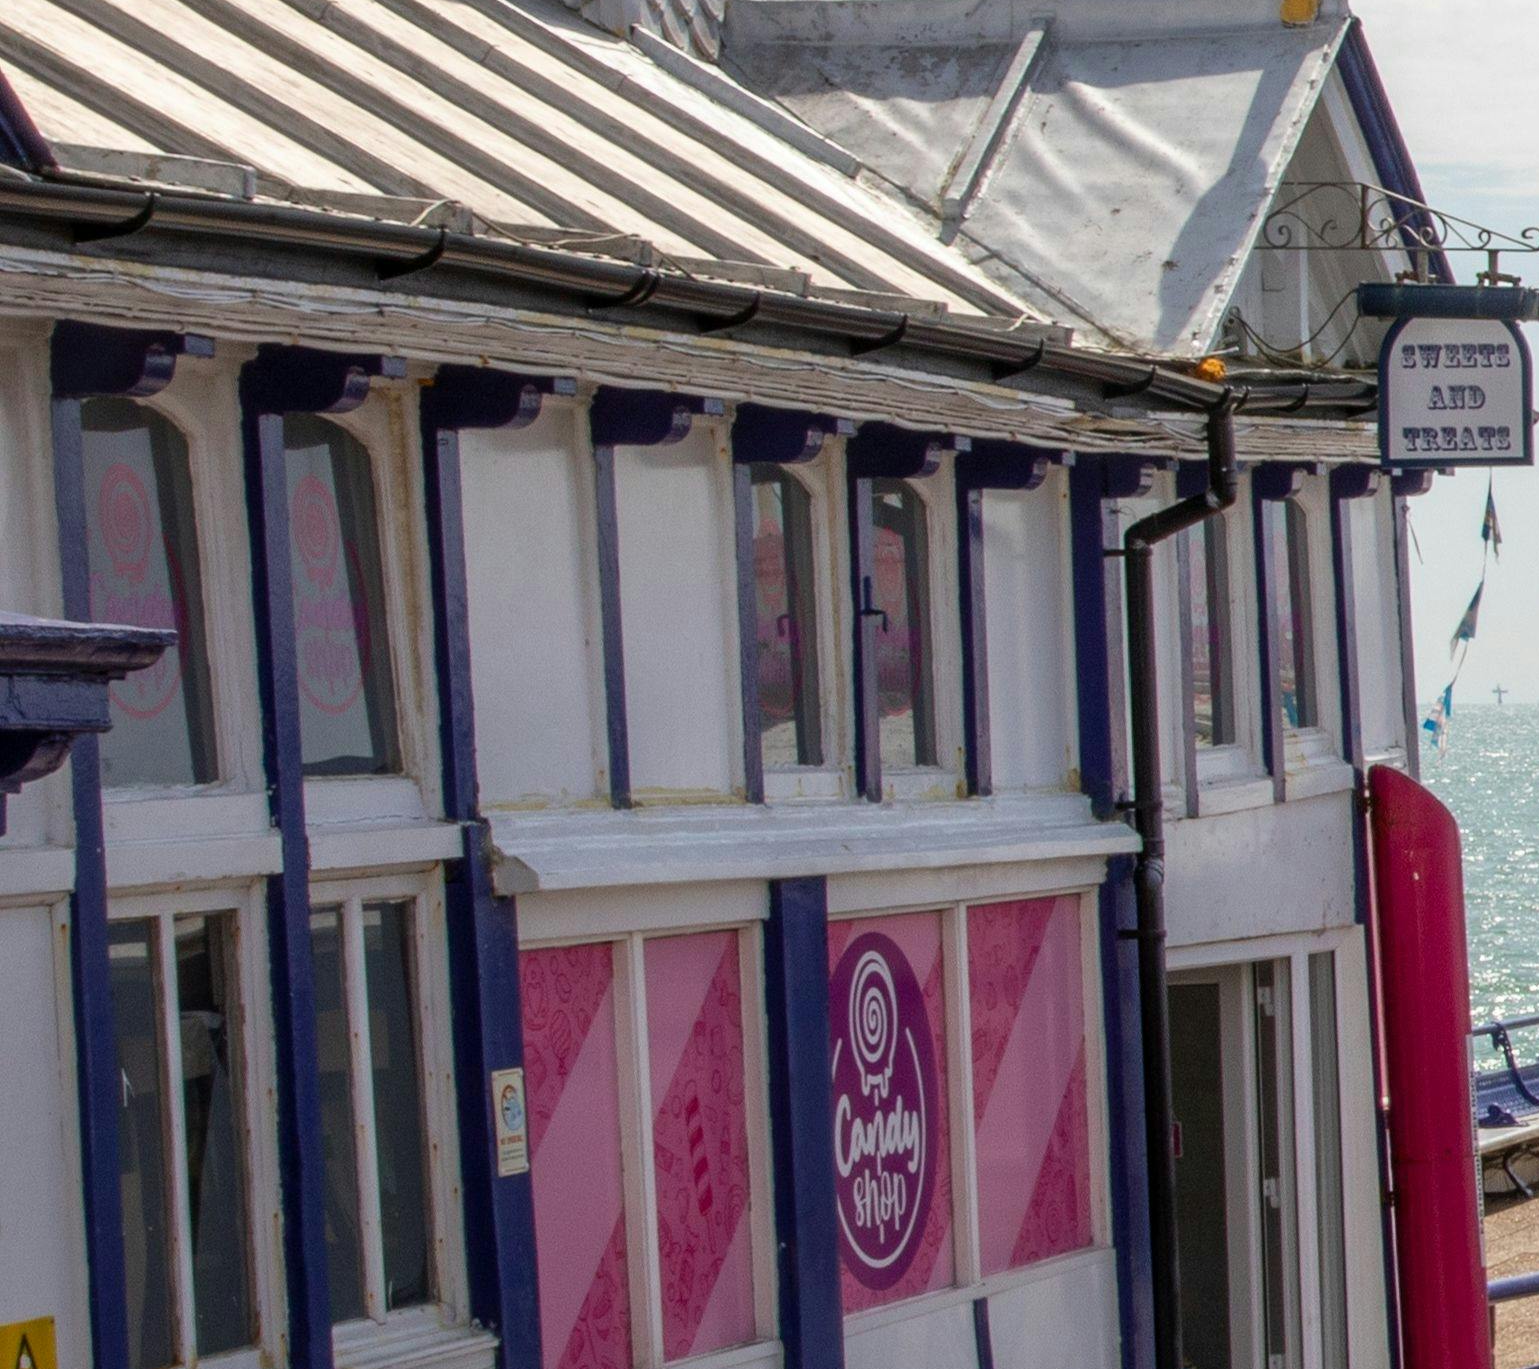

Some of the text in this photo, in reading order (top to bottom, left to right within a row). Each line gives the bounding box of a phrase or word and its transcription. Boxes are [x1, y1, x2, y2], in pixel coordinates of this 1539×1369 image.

[1402, 343, 1511, 368] SWEETS
[1428, 385, 1486, 409] AND
[1402, 426, 1511, 451] TREATS
[834, 1094, 920, 1178] Candy
[853, 1170, 907, 1232] shop
